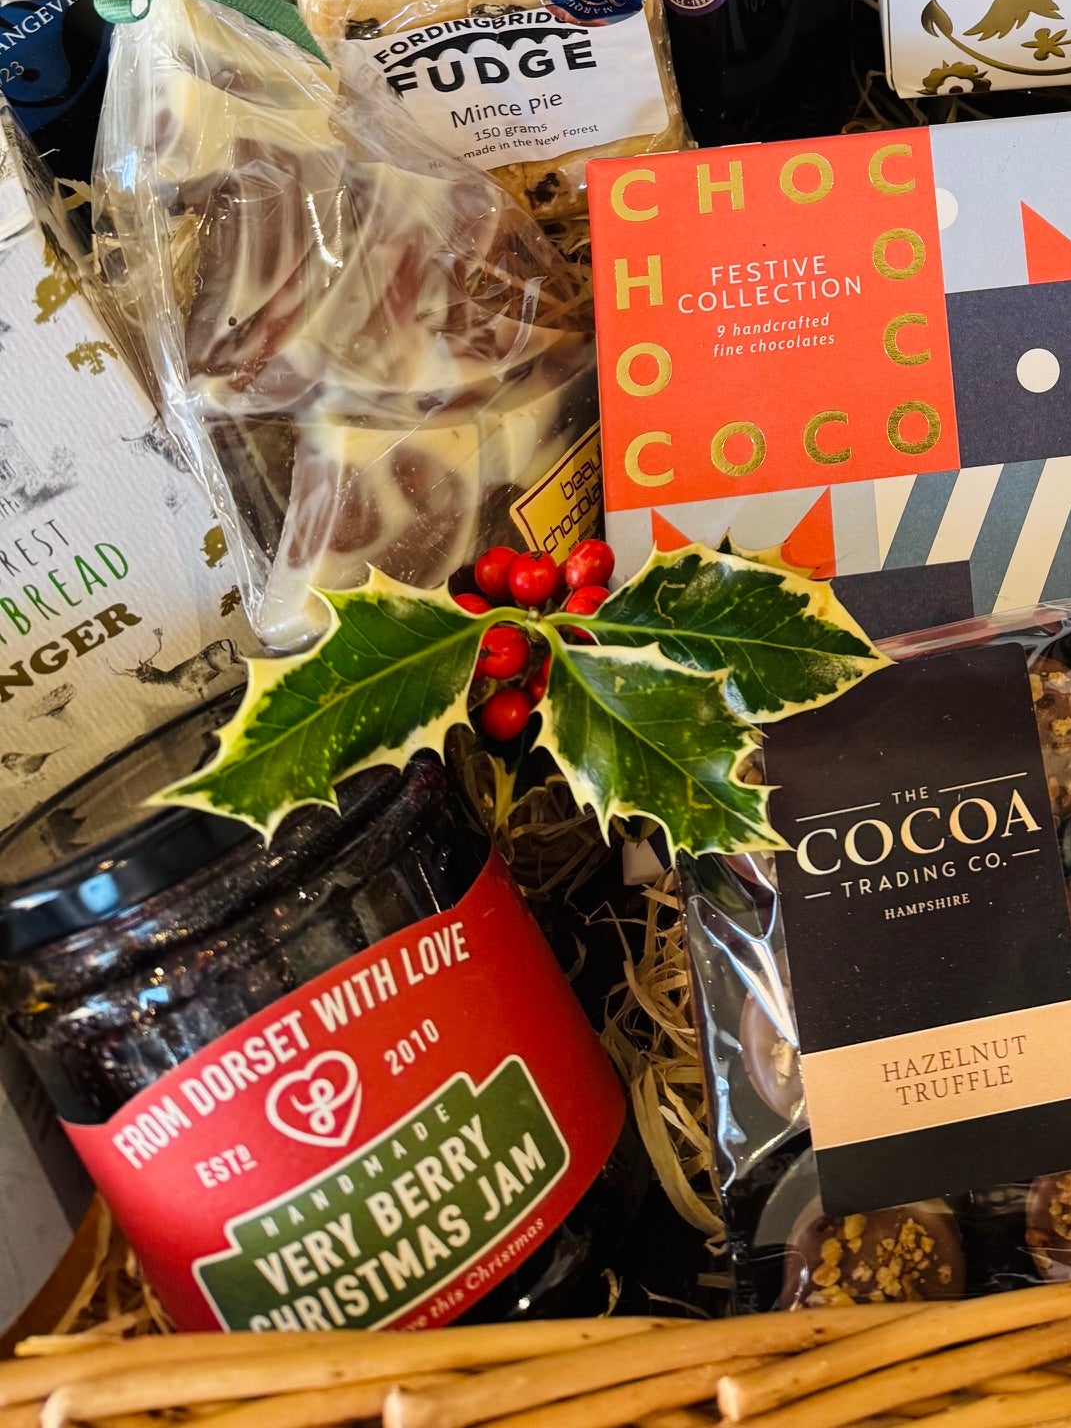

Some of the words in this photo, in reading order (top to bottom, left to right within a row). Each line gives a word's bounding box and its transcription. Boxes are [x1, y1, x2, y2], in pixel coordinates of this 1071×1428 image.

[386, 40, 598, 100] FUDGE
[451, 102, 523, 129] Mince
[528, 92, 563, 115] Pie
[474, 129, 501, 143] 150
[505, 122, 549, 138] grams
[499, 141, 511, 151] in
[512, 138, 533, 149] the
[535, 133, 561, 147] New
[562, 123, 599, 138] Forest
[711, 255, 828, 287] FESTIVE
[677, 276, 863, 315] COLLECTION
[712, 343, 747, 359] fine
[749, 333, 836, 356] chocolates
[716, 324, 726, 339] 9
[732, 313, 831, 338] handcrafted
[891, 786, 930, 805] THE
[795, 787, 1043, 876] COCOA
[840, 861, 957, 899] TRADING
[967, 851, 1009, 873] CO.
[884, 893, 971, 920] HAMPSHIRE
[111, 1094, 193, 1172] FROM
[179, 1009, 312, 1117] DORSET
[310, 957, 399, 1034] WITH
[400, 921, 471, 988] LOVE
[383, 1018, 441, 1077] 2010
[881, 1034, 1028, 1084] HAZELNUT
[895, 1064, 1014, 1107] TRUFFLE
[260, 1101, 451, 1239] HANDMADE
[477, 1132, 546, 1222] JAM
[253, 1212, 363, 1296] VERY
[365, 1113, 492, 1238] BERRY
[429, 1288, 465, 1319] this
[464, 1217, 546, 1291] Christmas
